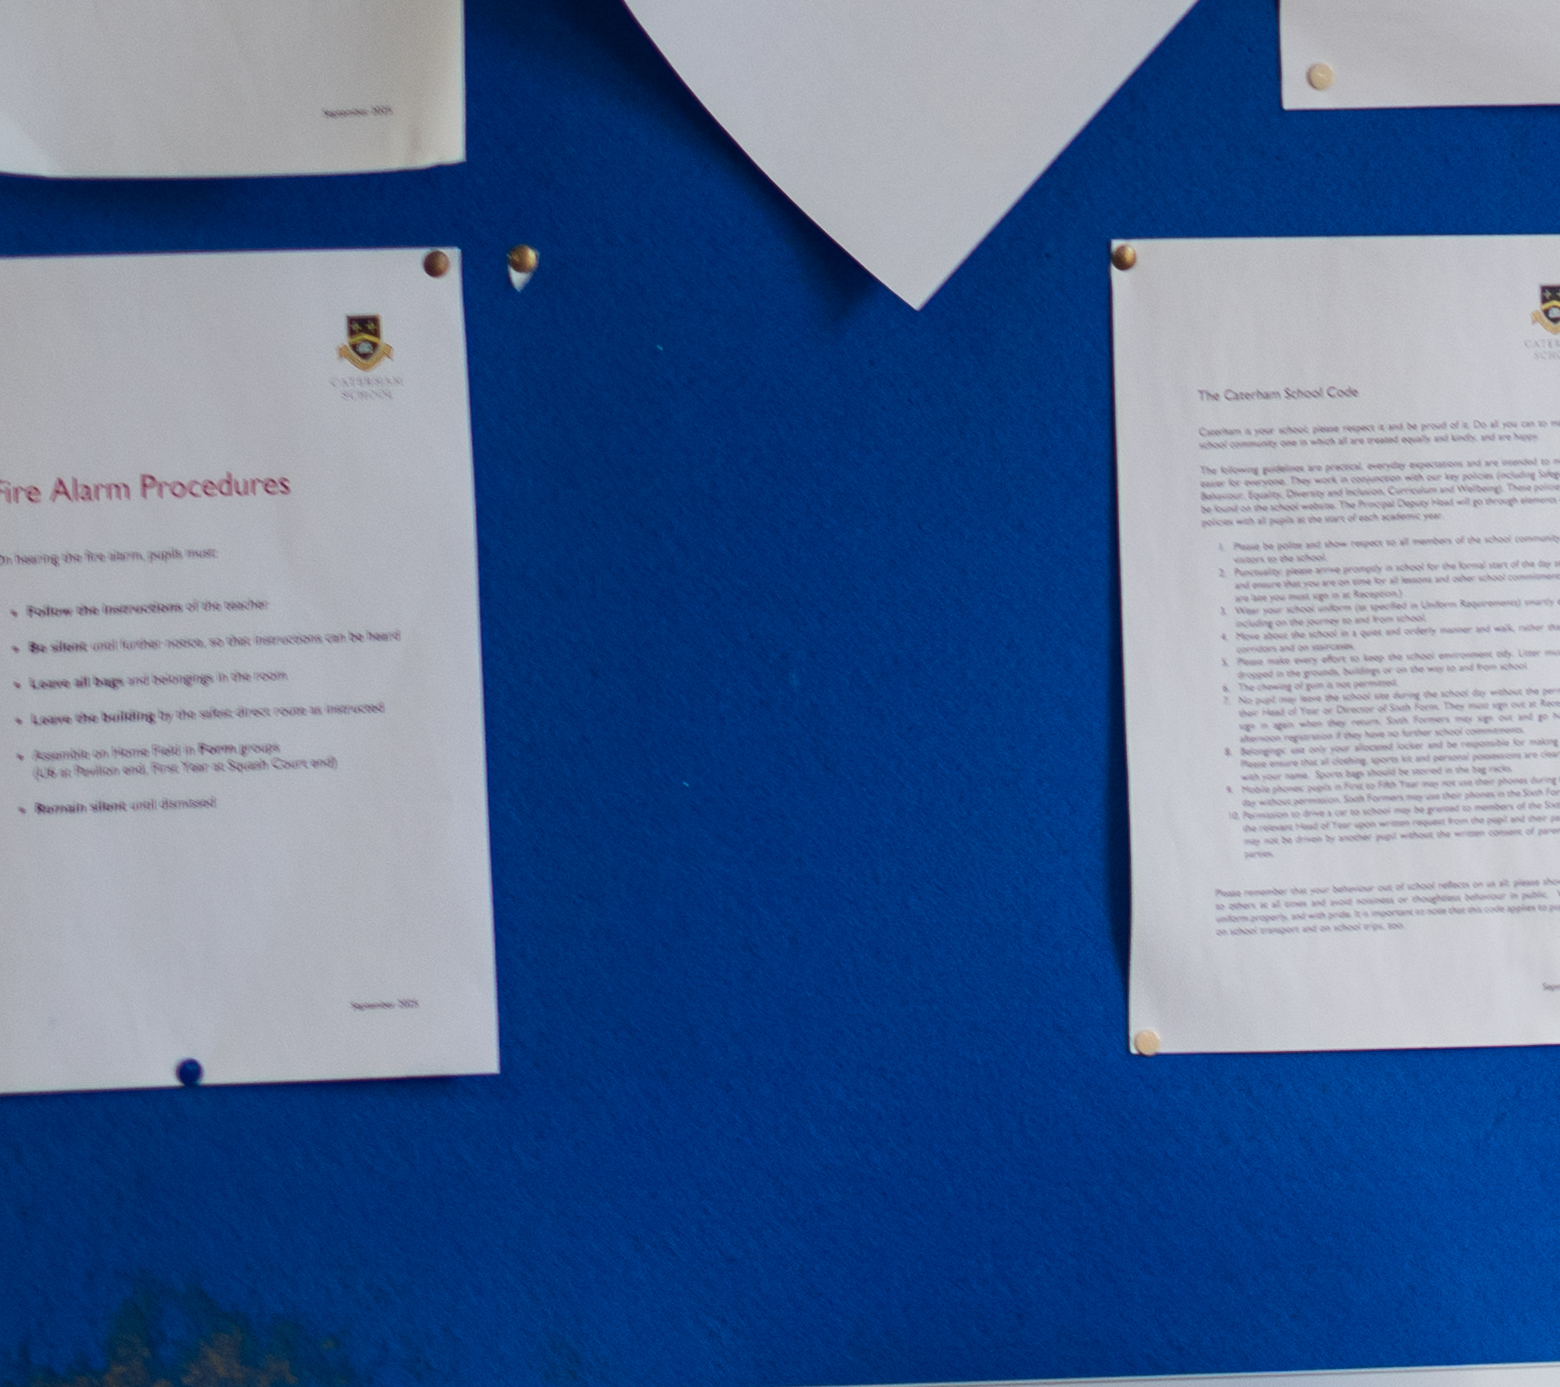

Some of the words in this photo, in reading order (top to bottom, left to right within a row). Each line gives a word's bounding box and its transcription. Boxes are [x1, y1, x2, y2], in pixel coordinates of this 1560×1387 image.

[1198, 387, 1220, 401] The
[1224, 386, 1280, 401] Caterham
[1284, 385, 1324, 400] School
[1326, 385, 1358, 399] Code
[1198, 427, 1242, 438] Caterham
[1244, 427, 1252, 437] is
[1254, 427, 1274, 438] your
[1312, 424, 1340, 437] please
[1342, 424, 1375, 436] respect
[1378, 423, 1385, 433] it
[1387, 423, 1404, 433] and
[1406, 422, 1418, 433] be
[1420, 422, 1448, 434] proud
[1450, 421, 1460, 432] of
[1472, 421, 1487, 431] Do
[1490, 420, 1500, 430] all
[1502, 421, 1518, 432] you
[1520, 420, 1535, 430] can
[1538, 419, 1547, 429] to
[1198, 439, 1228, 450] school
[1230, 438, 1278, 451] community
[1280, 439, 1297, 448] one
[1299, 437, 1308, 448] in
[1310, 437, 1336, 447] which
[1338, 437, 1348, 447] all
[1350, 437, 1364, 447] are
[1366, 435, 1400, 446] treated
[1400, 435, 1430, 447] equally
[1434, 434, 1449, 445] and
[1480, 433, 1496, 444] and
[1498, 434, 1512, 443] are
[1200, 465, 1217, 475] The
[1220, 464, 1258, 476] following
[1262, 463, 1304, 475] guidelines
[1308, 463, 1322, 473] are
[1367, 460, 1406, 473] everyday
[1409, 459, 1462, 472] expectations
[1466, 458, 1482, 469] and
[1484, 459, 1498, 468] are
[1502, 457, 1538, 468] intended
[1540, 457, 1550, 467] to
[50, 476, 131, 503] Alarm
[140, 470, 291, 499] Procedures
[1200, 478, 1224, 488] easier
[1228, 478, 1240, 488] for
[1290, 476, 1310, 488] They
[1314, 475, 1337, 486] work
[1340, 475, 1348, 485] in
[1350, 474, 1401, 486] conjunction
[1404, 473, 1424, 484] with
[1426, 474, 1440, 483] our
[1444, 472, 1458, 484] key
[1462, 472, 1493, 484] policies
[1496, 471, 1536, 483] (including
[14, 552, 60, 567] hearing
[62, 552, 82, 564] the
[84, 551, 106, 563] fire
[108, 549, 143, 564] alarm,
[146, 548, 182, 562] pupils
[26, 604, 72, 618] Follow
[76, 603, 100, 616] the
[101, 601, 183, 615] instructions
[186, 600, 199, 612] of
[201, 599, 221, 611] the
[224, 598, 268, 611] teacher
[27, 640, 48, 652] Be
[50, 639, 88, 652] silent
[92, 638, 118, 650] until
[120, 637, 160, 650] further
[166, 636, 204, 650] notice,
[209, 638, 224, 647] so
[226, 634, 250, 647] that
[254, 632, 322, 646] instructions
[325, 634, 346, 644] can
[348, 631, 364, 643] be
[366, 630, 401, 643] heard
[29, 676, 70, 689] Leave
[74, 675, 91, 687] all
[92, 674, 124, 688] bags
[128, 673, 150, 685] and
[152, 671, 214, 686] belongings
[218, 671, 227, 682] in
[231, 670, 250, 682] the
[255, 671, 287, 681] room
[30, 712, 72, 724] Leave
[74, 711, 98, 723] the
[100, 709, 156, 724] building
[158, 708, 172, 722] by
[176, 708, 196, 720] the
[236, 705, 270, 718] direct
[274, 704, 306, 717] route
[310, 706, 322, 715] as
[326, 702, 385, 715] instructed
[32, 747, 89, 760] Assemble
[93, 749, 108, 758] on
[111, 745, 149, 758] Home
[152, 744, 182, 756] Field
[184, 743, 195, 755] in
[197, 742, 237, 755] Form
[238, 743, 280, 755] groups
[60, 765, 71, 777] at
[74, 763, 119, 776] Pavilion
[150, 761, 178, 774] First
[182, 760, 208, 773] Year
[212, 760, 224, 772] at
[227, 758, 268, 773] Squash
[270, 757, 308, 770] Court
[310, 756, 338, 770] end)
[34, 801, 86, 814] Remain
[90, 799, 126, 812] silent
[130, 798, 157, 811] until
[160, 796, 216, 810] dismissed
